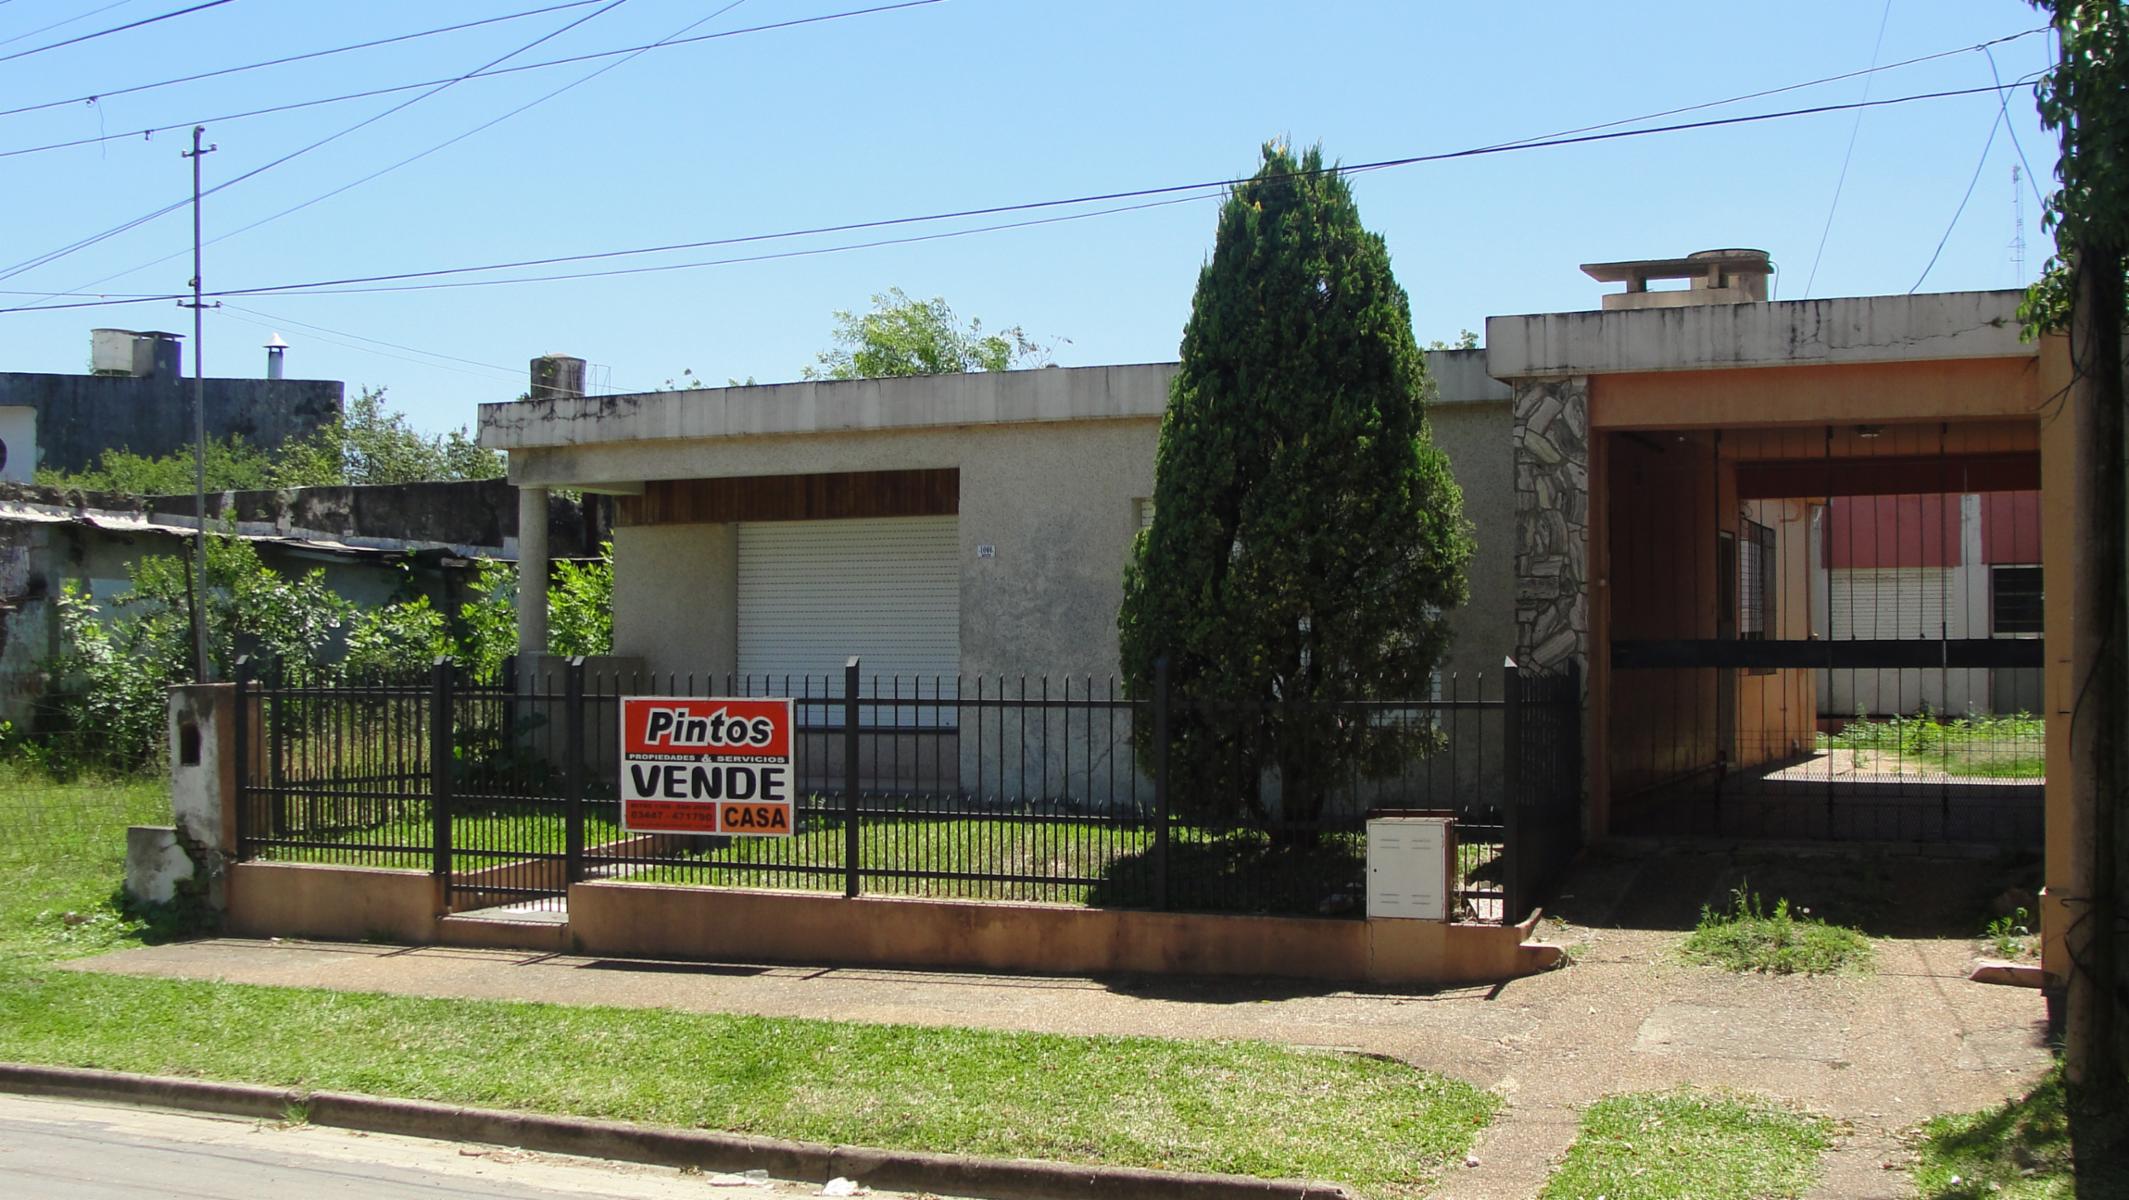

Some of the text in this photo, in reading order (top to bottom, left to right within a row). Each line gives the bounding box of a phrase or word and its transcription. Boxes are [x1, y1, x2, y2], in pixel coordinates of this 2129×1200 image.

[645, 707, 774, 746] Pintos
[629, 753, 785, 763] PROPIEDADES & SERVICIOS
[631, 764, 785, 801] VENDE
[724, 807, 787, 828] CASA
